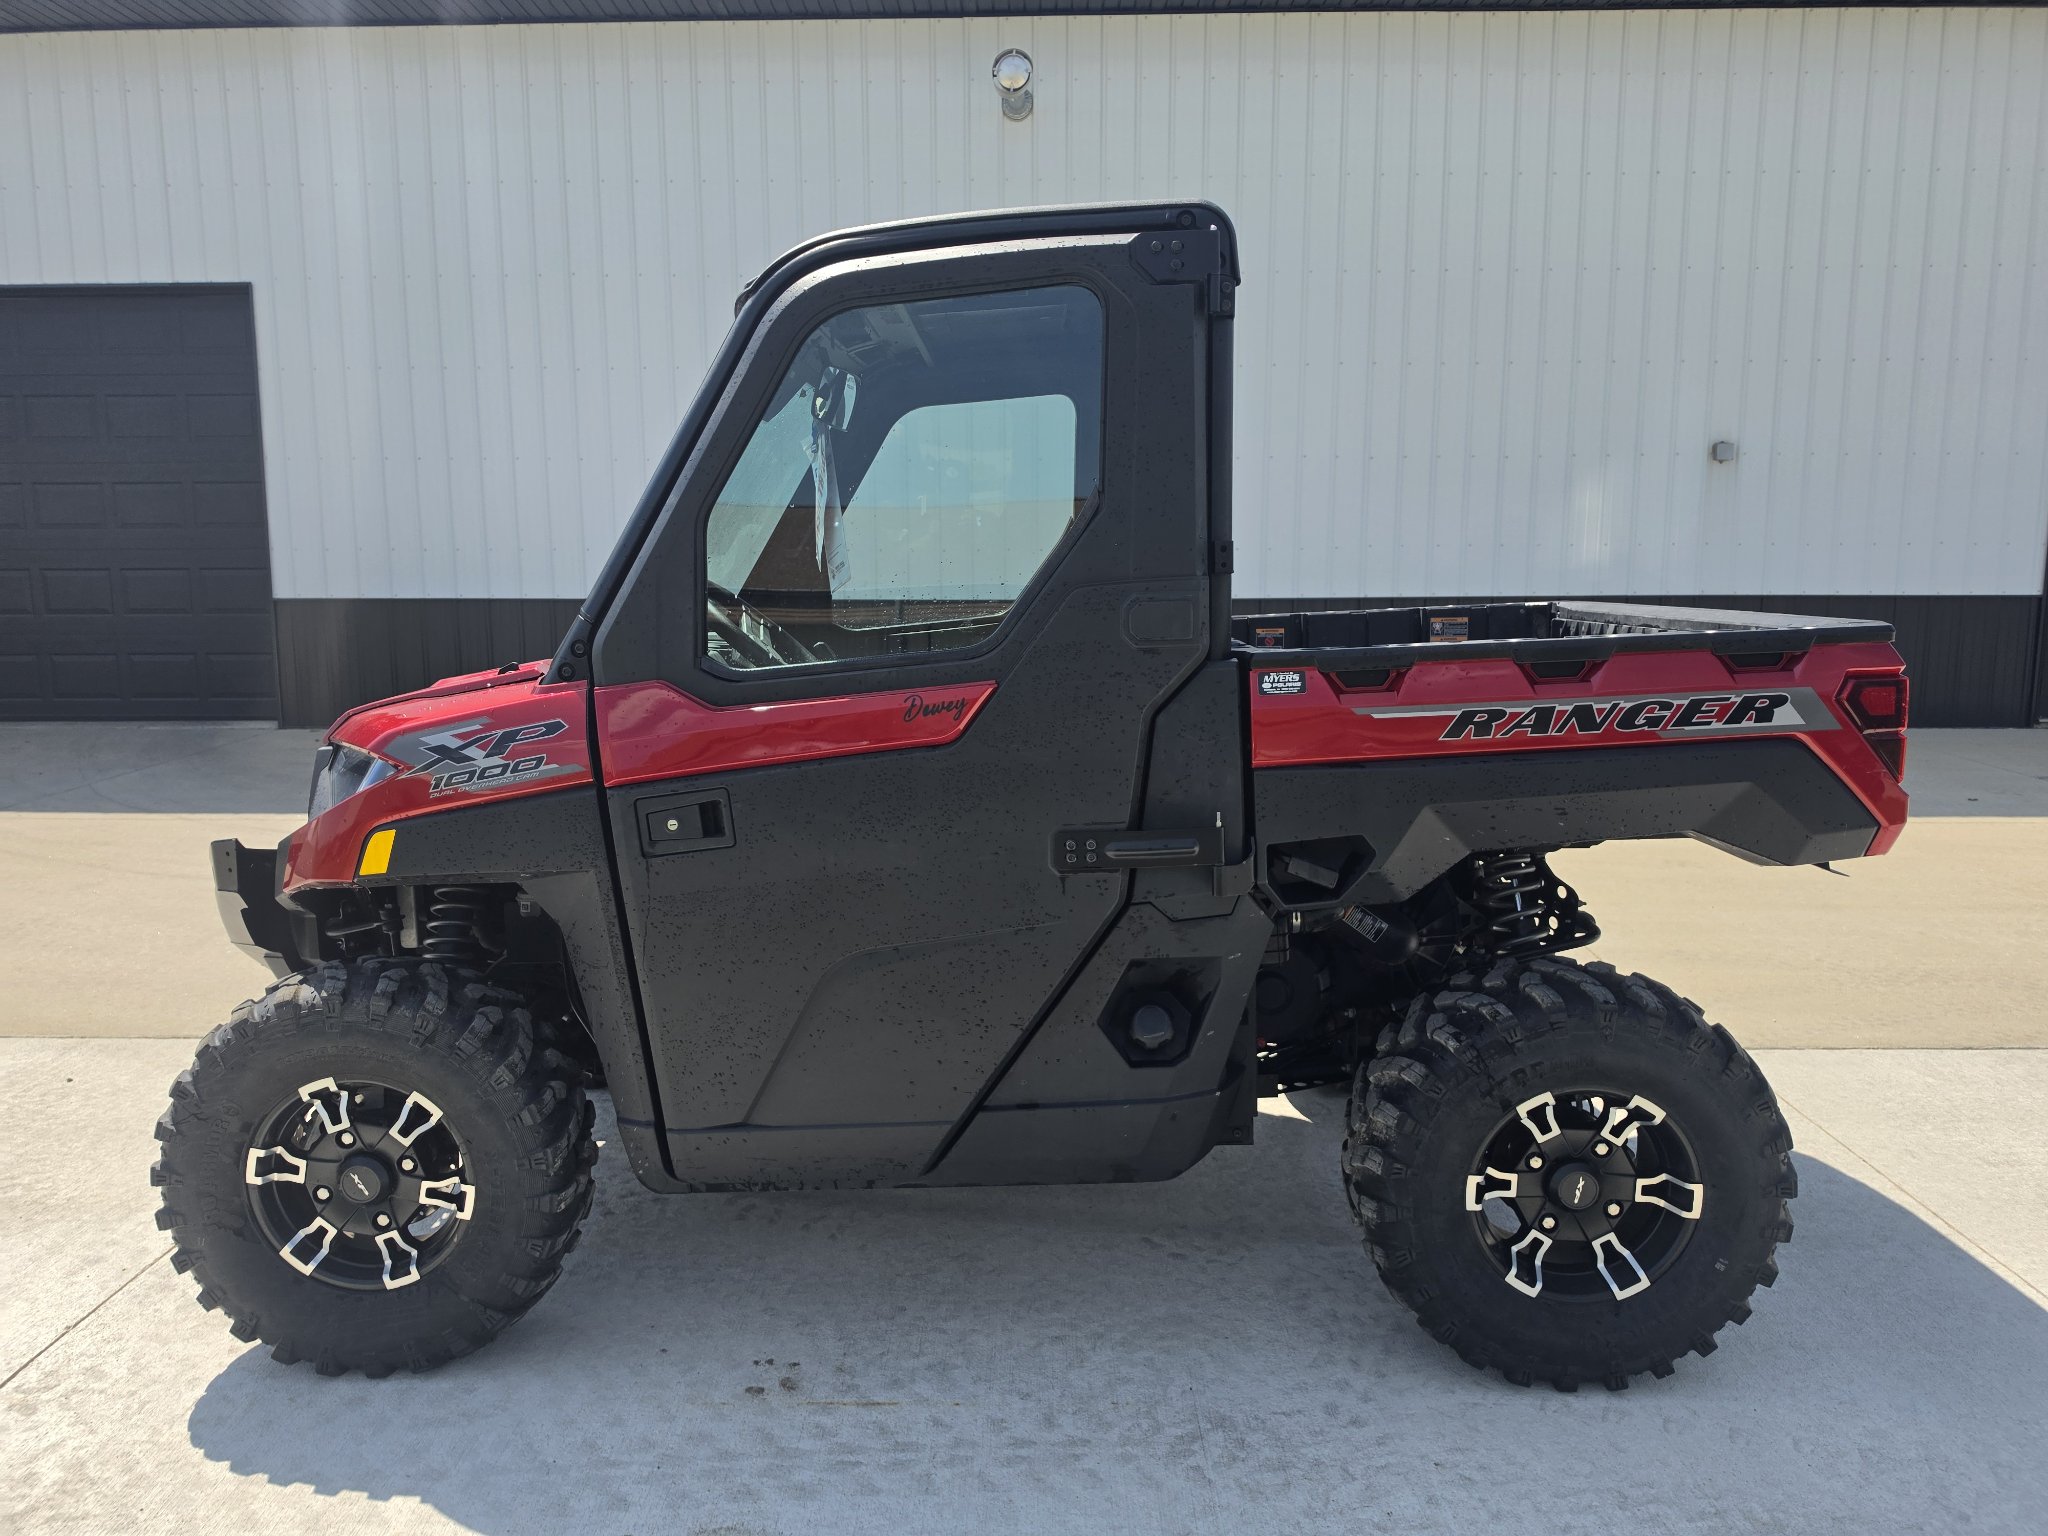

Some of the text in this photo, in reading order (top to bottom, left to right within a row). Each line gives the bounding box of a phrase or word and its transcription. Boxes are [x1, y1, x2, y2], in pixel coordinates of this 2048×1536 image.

[1263, 673, 1300, 683] MYERS
[903, 694, 968, 722] Dewey
[1438, 692, 1791, 741] RANGER
[396, 718, 569, 780] XP
[429, 753, 548, 793] 1000
[429, 771, 540, 799] DUAL OVERHEAD CAM
